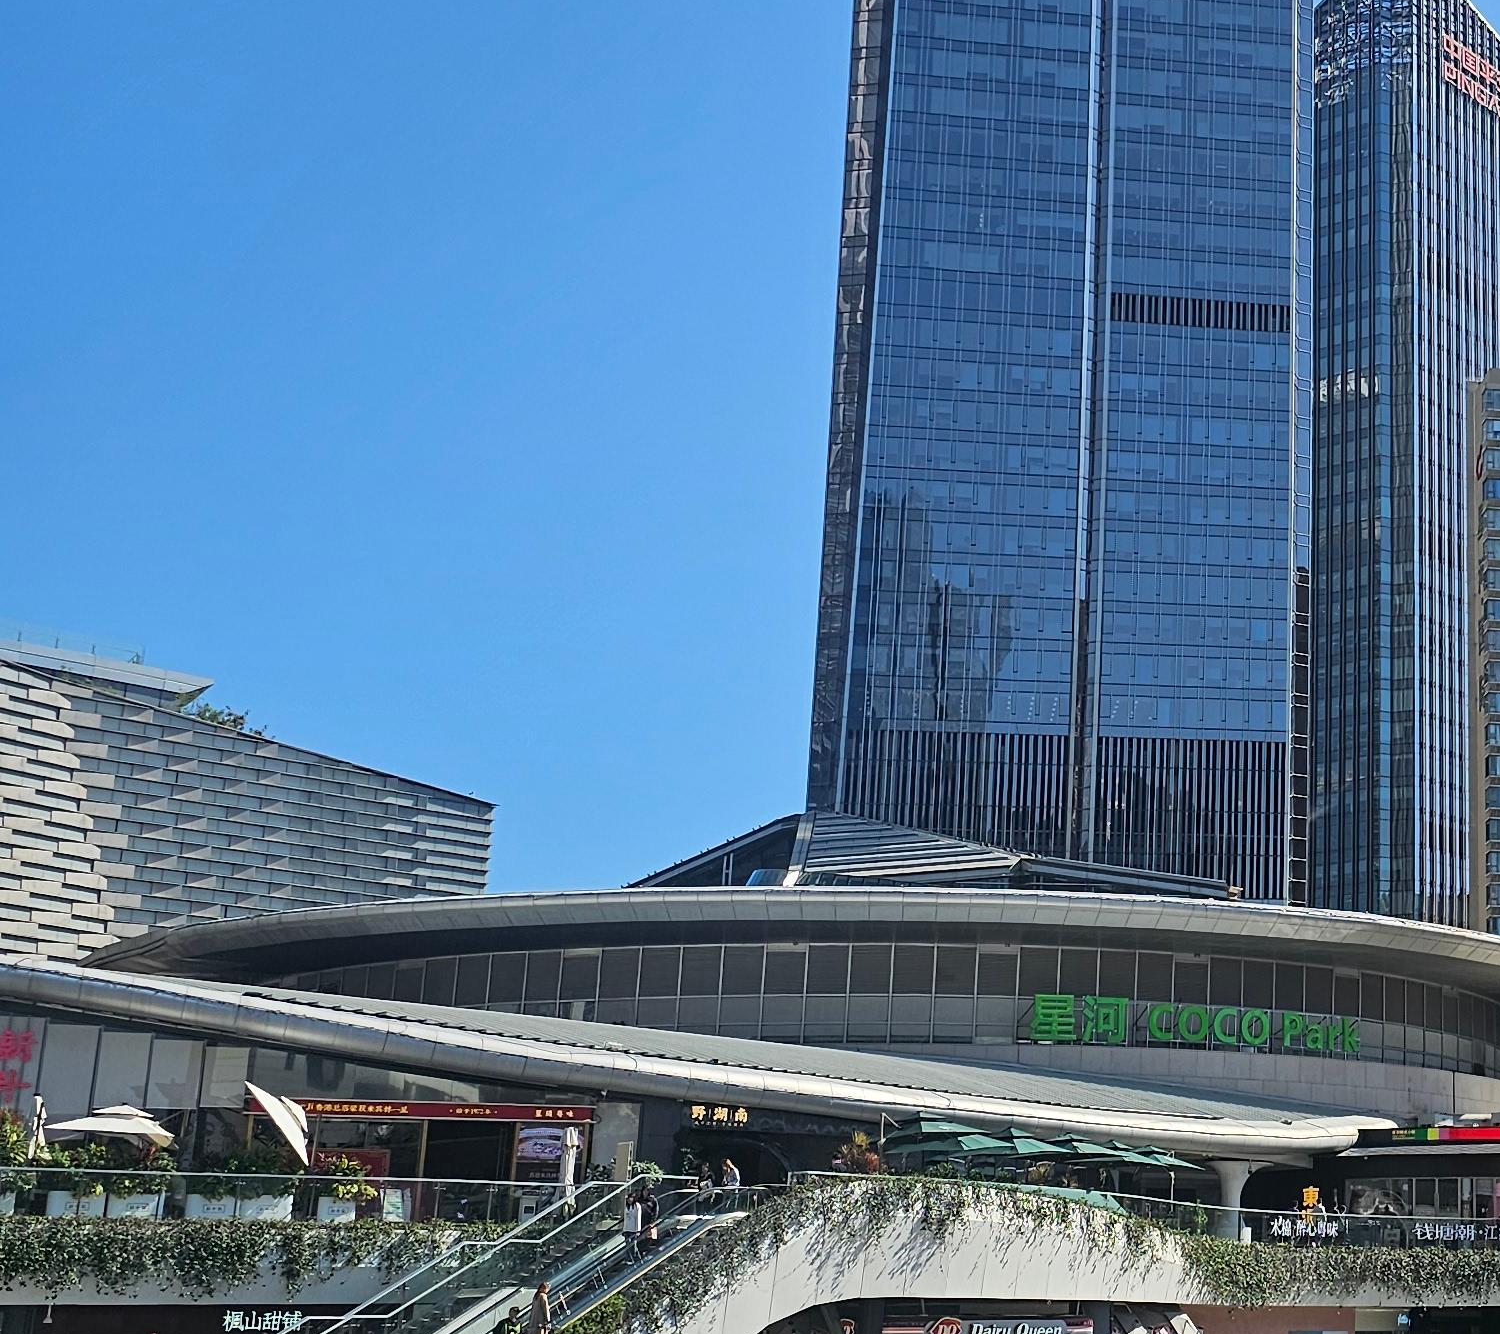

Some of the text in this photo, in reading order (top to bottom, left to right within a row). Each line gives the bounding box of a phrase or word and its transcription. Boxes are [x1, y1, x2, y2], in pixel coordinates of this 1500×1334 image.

[1030, 993, 1361, 1052] 星河 COCO Park
